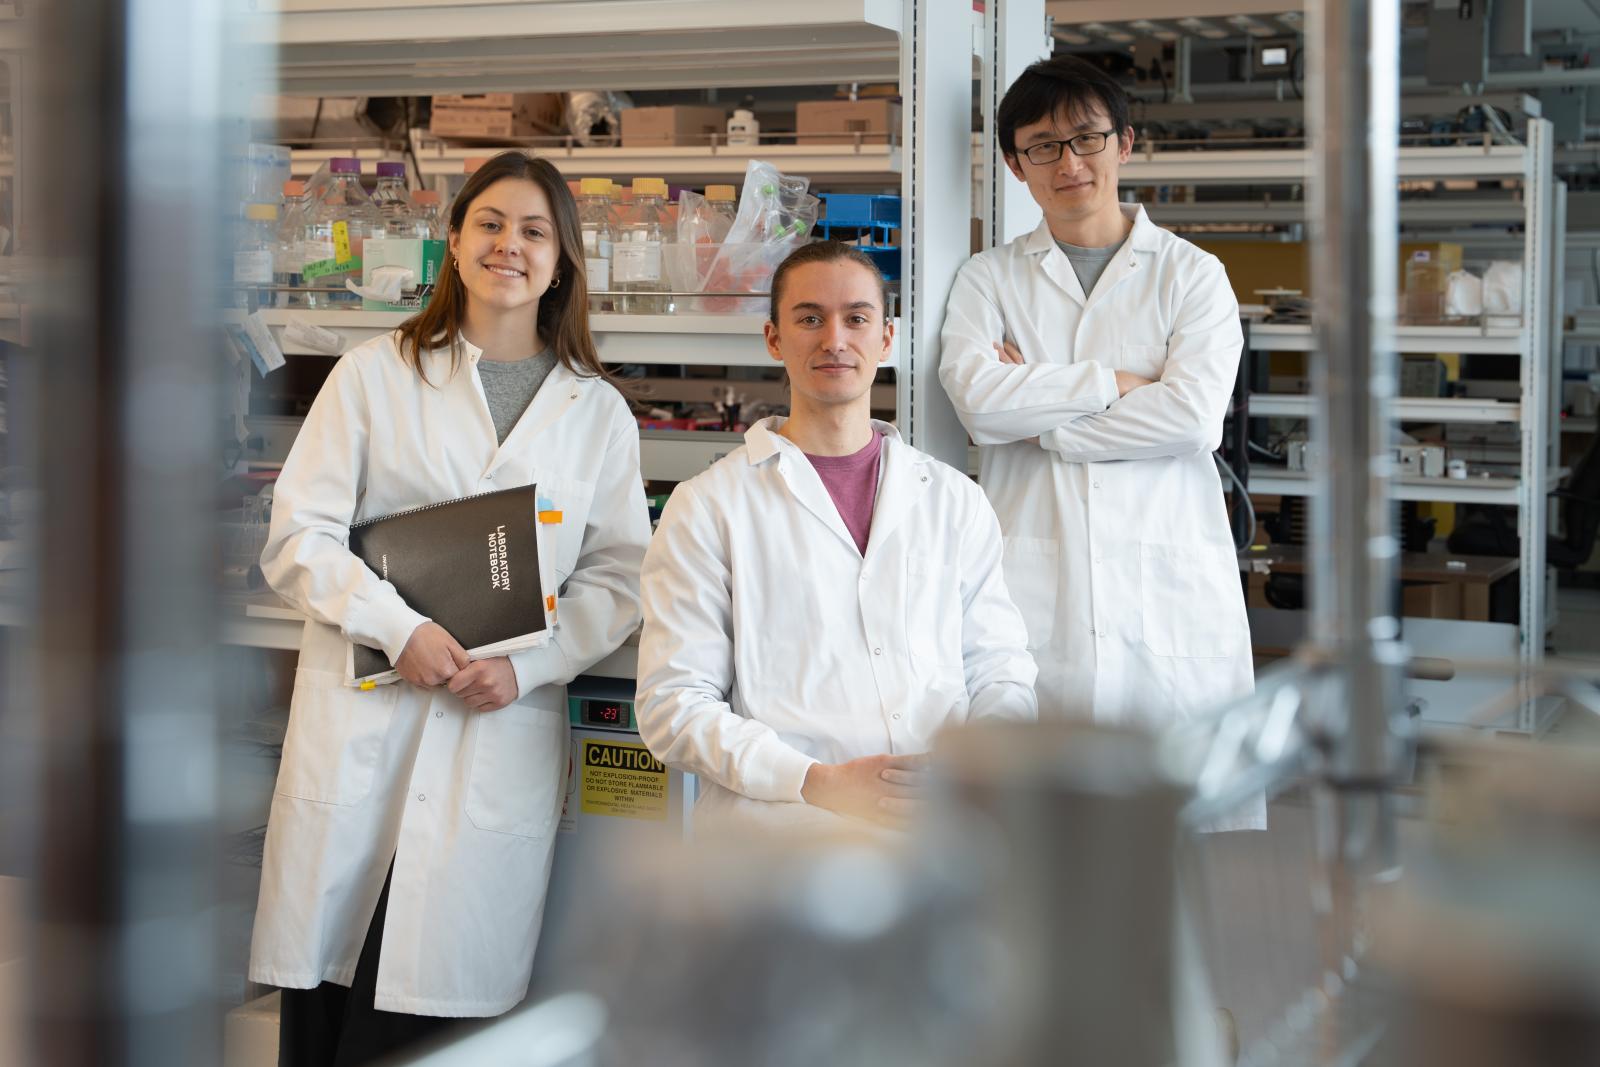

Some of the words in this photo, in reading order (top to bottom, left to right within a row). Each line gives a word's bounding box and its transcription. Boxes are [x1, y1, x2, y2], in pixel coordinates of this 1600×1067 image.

[488, 533, 500, 590] NOTEBOOK
[497, 525, 511, 591] LABORATORY
[600, 707, 617, 720] -23
[588, 746, 662, 770] CAUTION
[603, 771, 658, 782] EXPLOSION-PROOF
[597, 786, 628, 794] EXPLOSIVE
[630, 789, 663, 798] MATERIALS
[628, 782, 664, 791] FLAMMABLE
[614, 795, 635, 803] WITHIN
